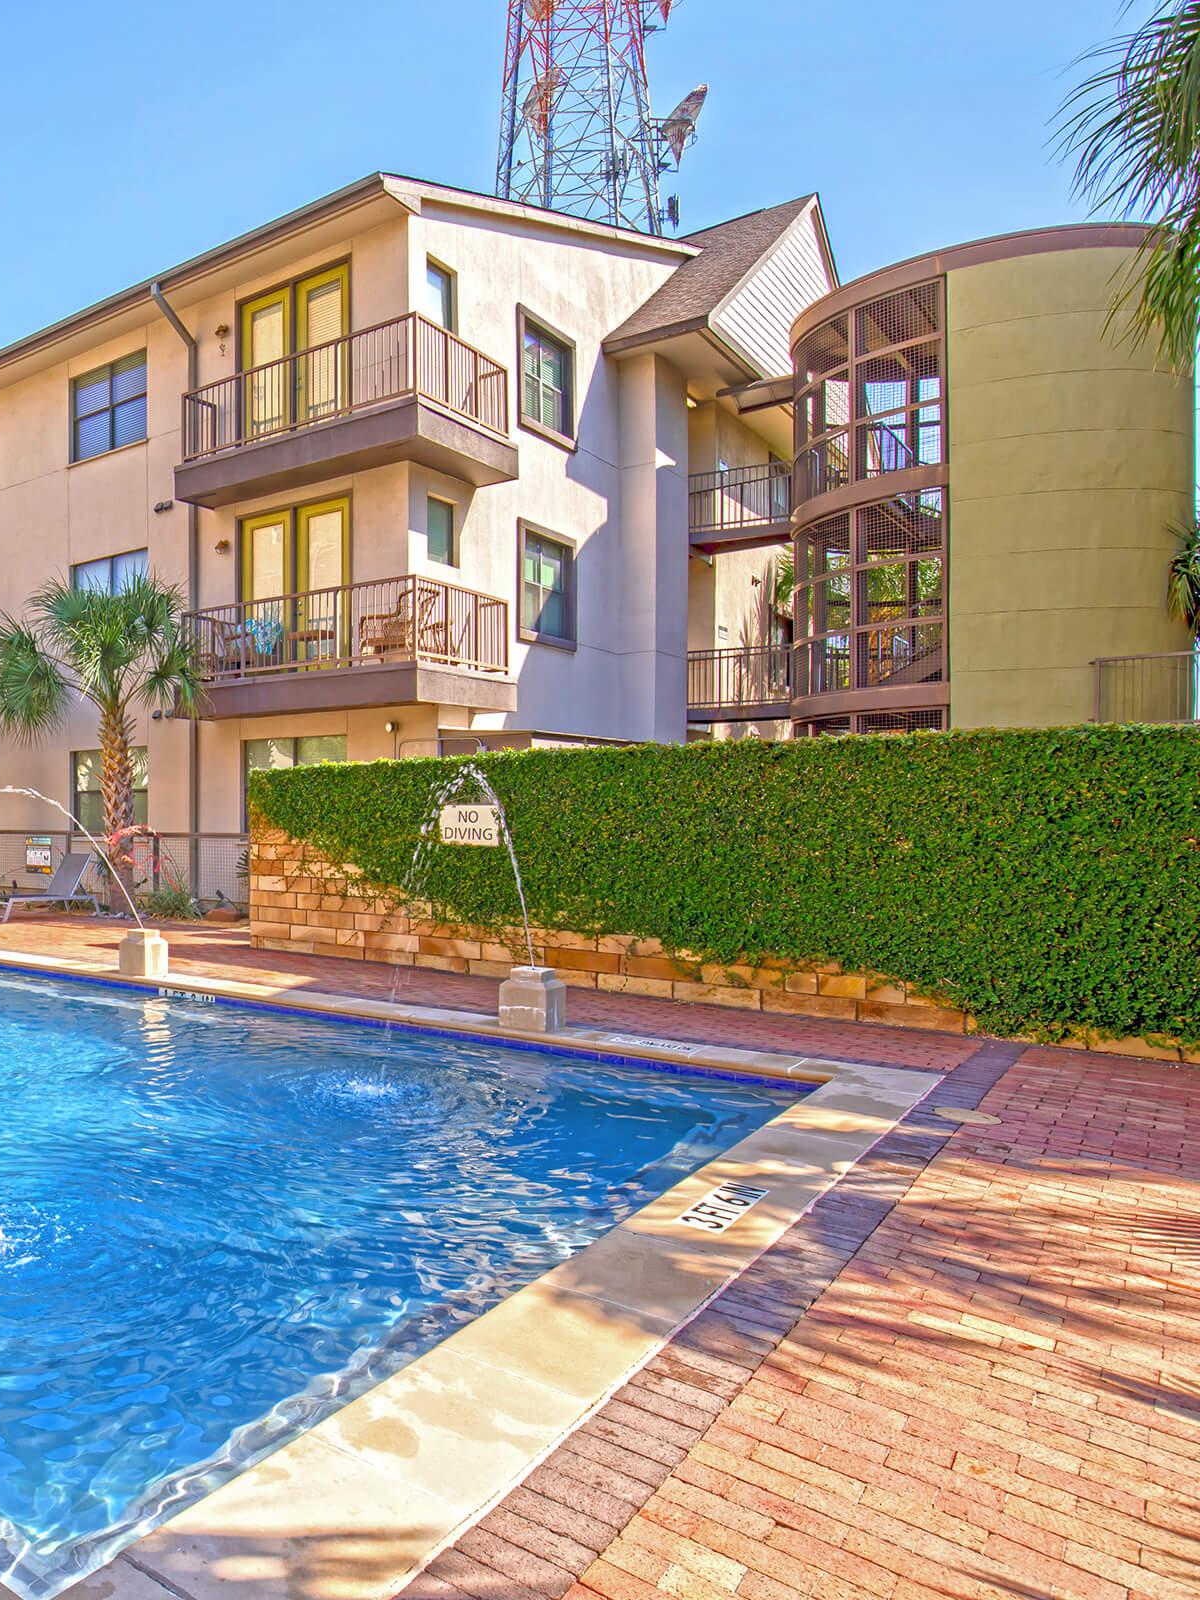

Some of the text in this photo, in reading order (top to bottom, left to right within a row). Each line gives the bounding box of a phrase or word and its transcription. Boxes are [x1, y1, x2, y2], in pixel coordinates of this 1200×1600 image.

[458, 811, 479, 823] NO
[444, 827, 493, 841] DIVING
[681, 1182, 767, 1229] 3 FT 6 IN
